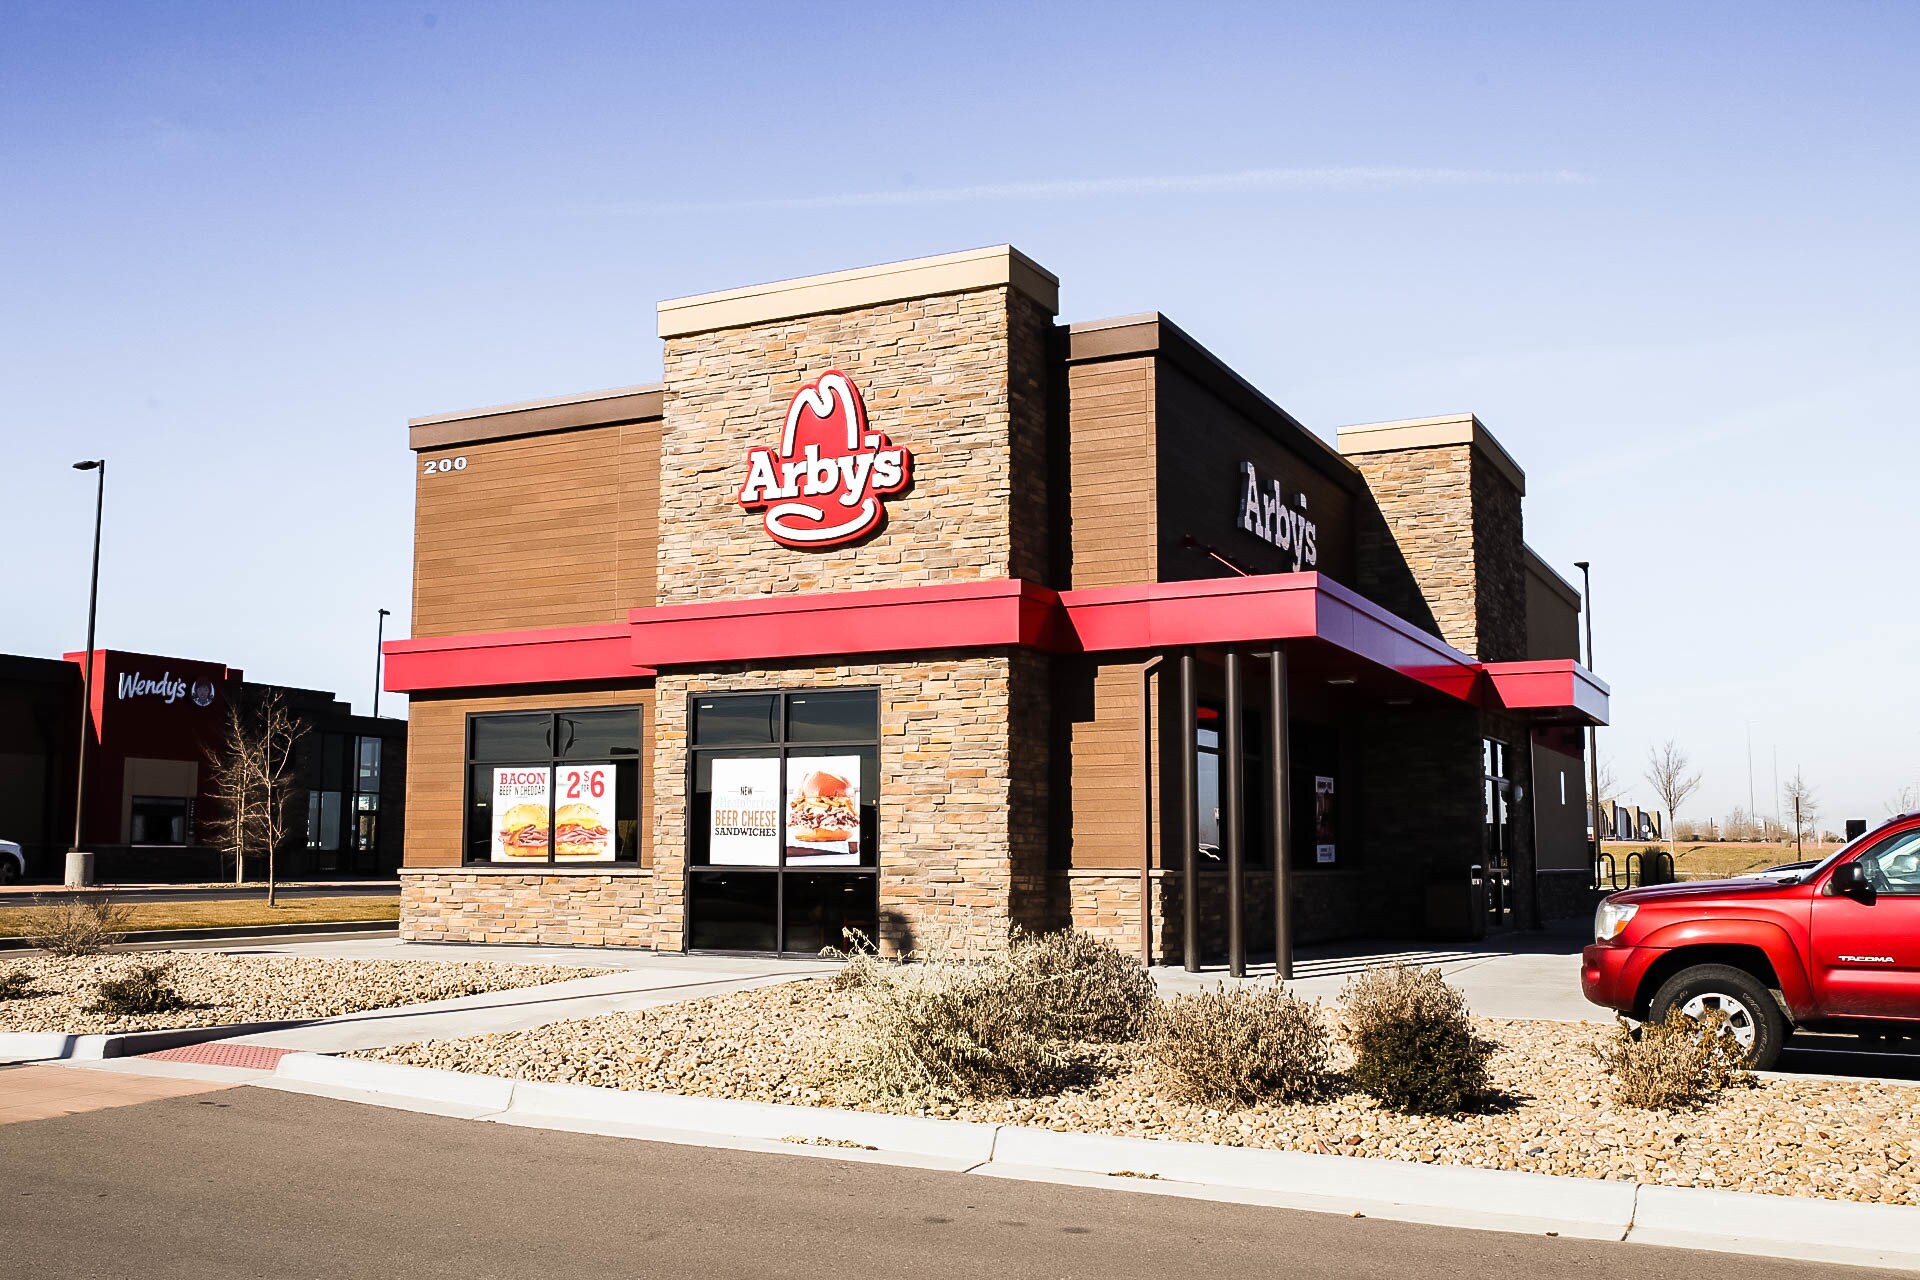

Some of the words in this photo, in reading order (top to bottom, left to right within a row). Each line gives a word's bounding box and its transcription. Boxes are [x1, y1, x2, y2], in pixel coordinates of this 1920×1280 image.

[423, 456, 467, 475] 200
[741, 434, 903, 507] Arby's
[1243, 461, 1317, 573] Arby's
[118, 671, 187, 705] Wendy's
[500, 772, 546, 785] BACON
[567, 771, 580, 798] 2
[499, 785, 512, 796] BEEF
[740, 786, 753, 796] NEW
[715, 809, 738, 827] BEER
[741, 810, 776, 828] CHEESE
[714, 828, 777, 837] SANDWICHES
[1837, 955, 1895, 963] TACOMA
